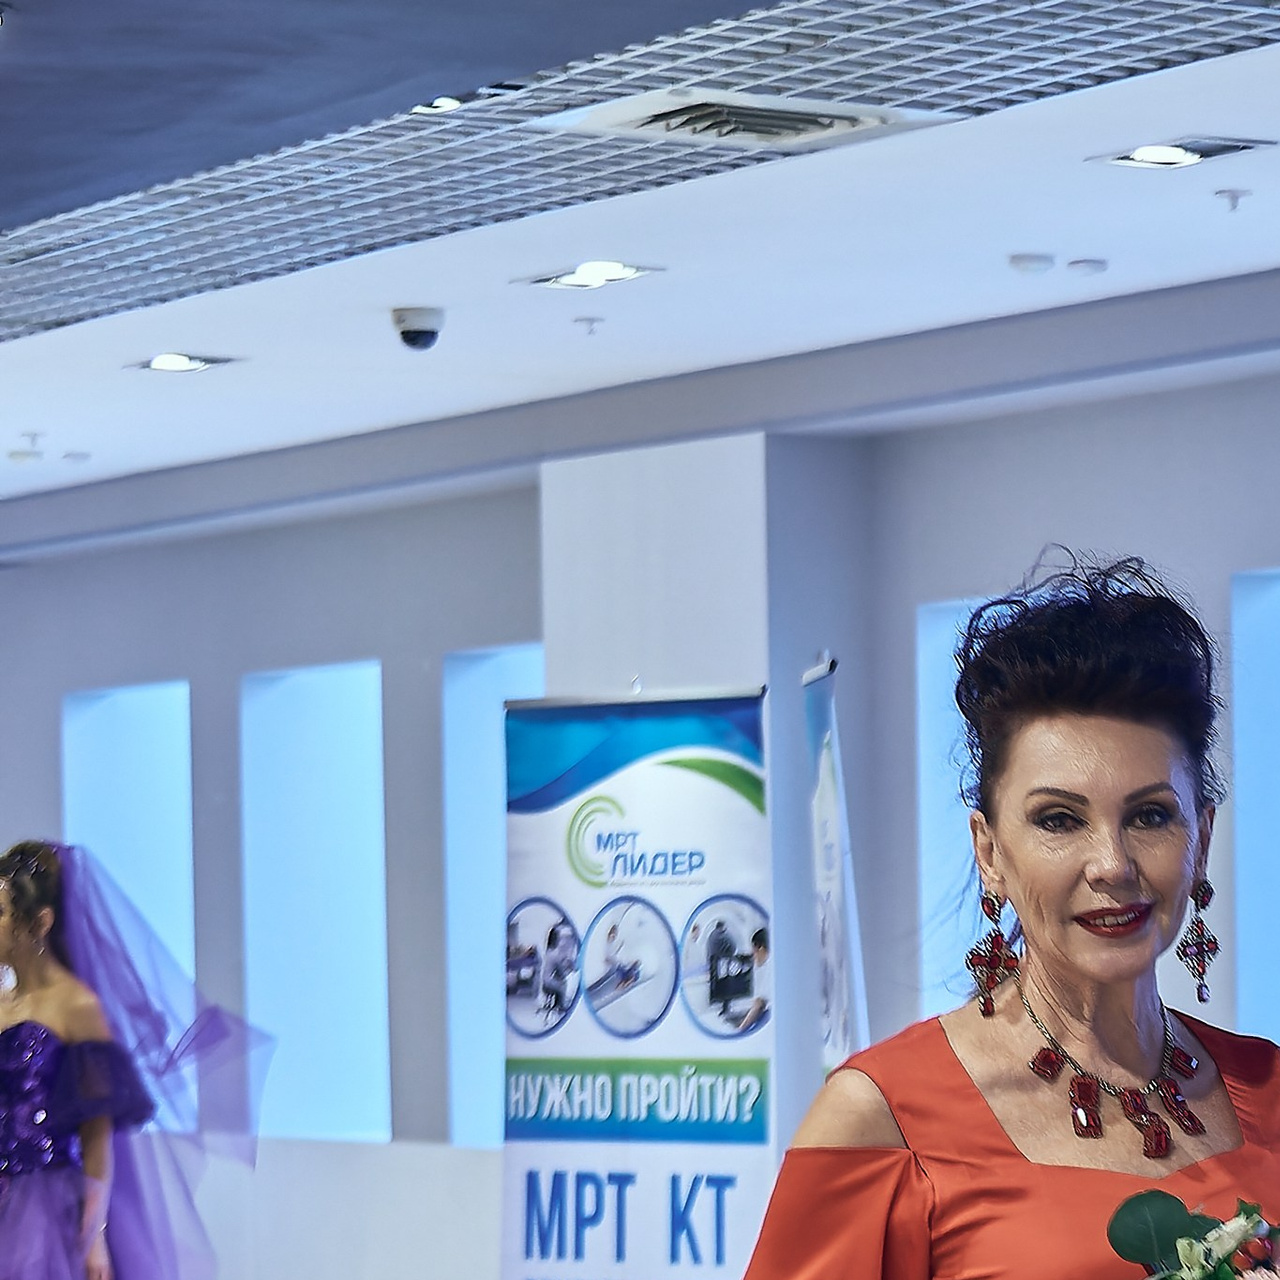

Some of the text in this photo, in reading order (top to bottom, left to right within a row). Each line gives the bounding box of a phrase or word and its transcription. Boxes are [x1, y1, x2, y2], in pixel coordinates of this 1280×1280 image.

[596, 832, 639, 852] МРТ
[611, 851, 705, 876] ЛИДЕР
[508, 1064, 762, 1123] НУЖНО ПРОЙТИ?
[525, 1170, 737, 1266] МРТ КТ
